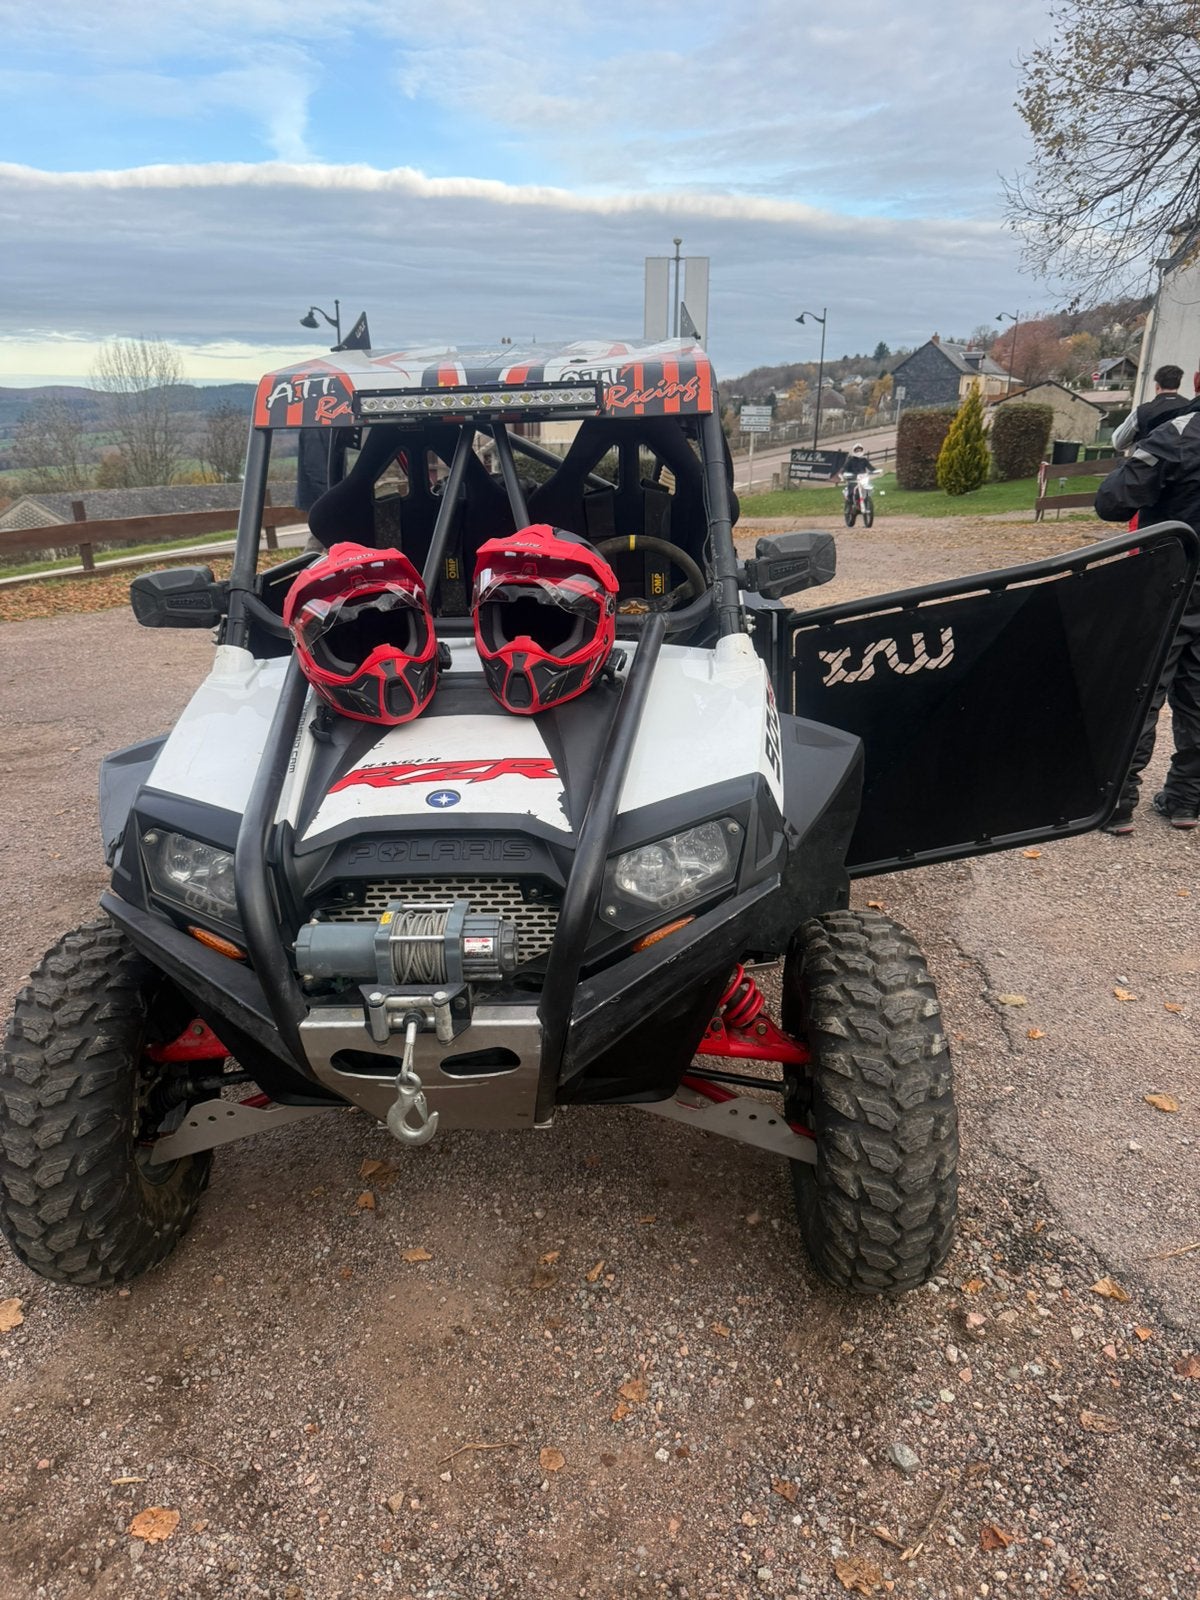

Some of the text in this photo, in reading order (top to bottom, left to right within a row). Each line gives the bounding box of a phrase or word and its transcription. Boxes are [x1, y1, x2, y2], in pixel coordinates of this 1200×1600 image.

[606, 376, 699, 410] Racing
[448, 558, 457, 579] OMP
[654, 573, 662, 594] OMP
[328, 757, 560, 794] RZR
[348, 838, 535, 866] POLARIS
